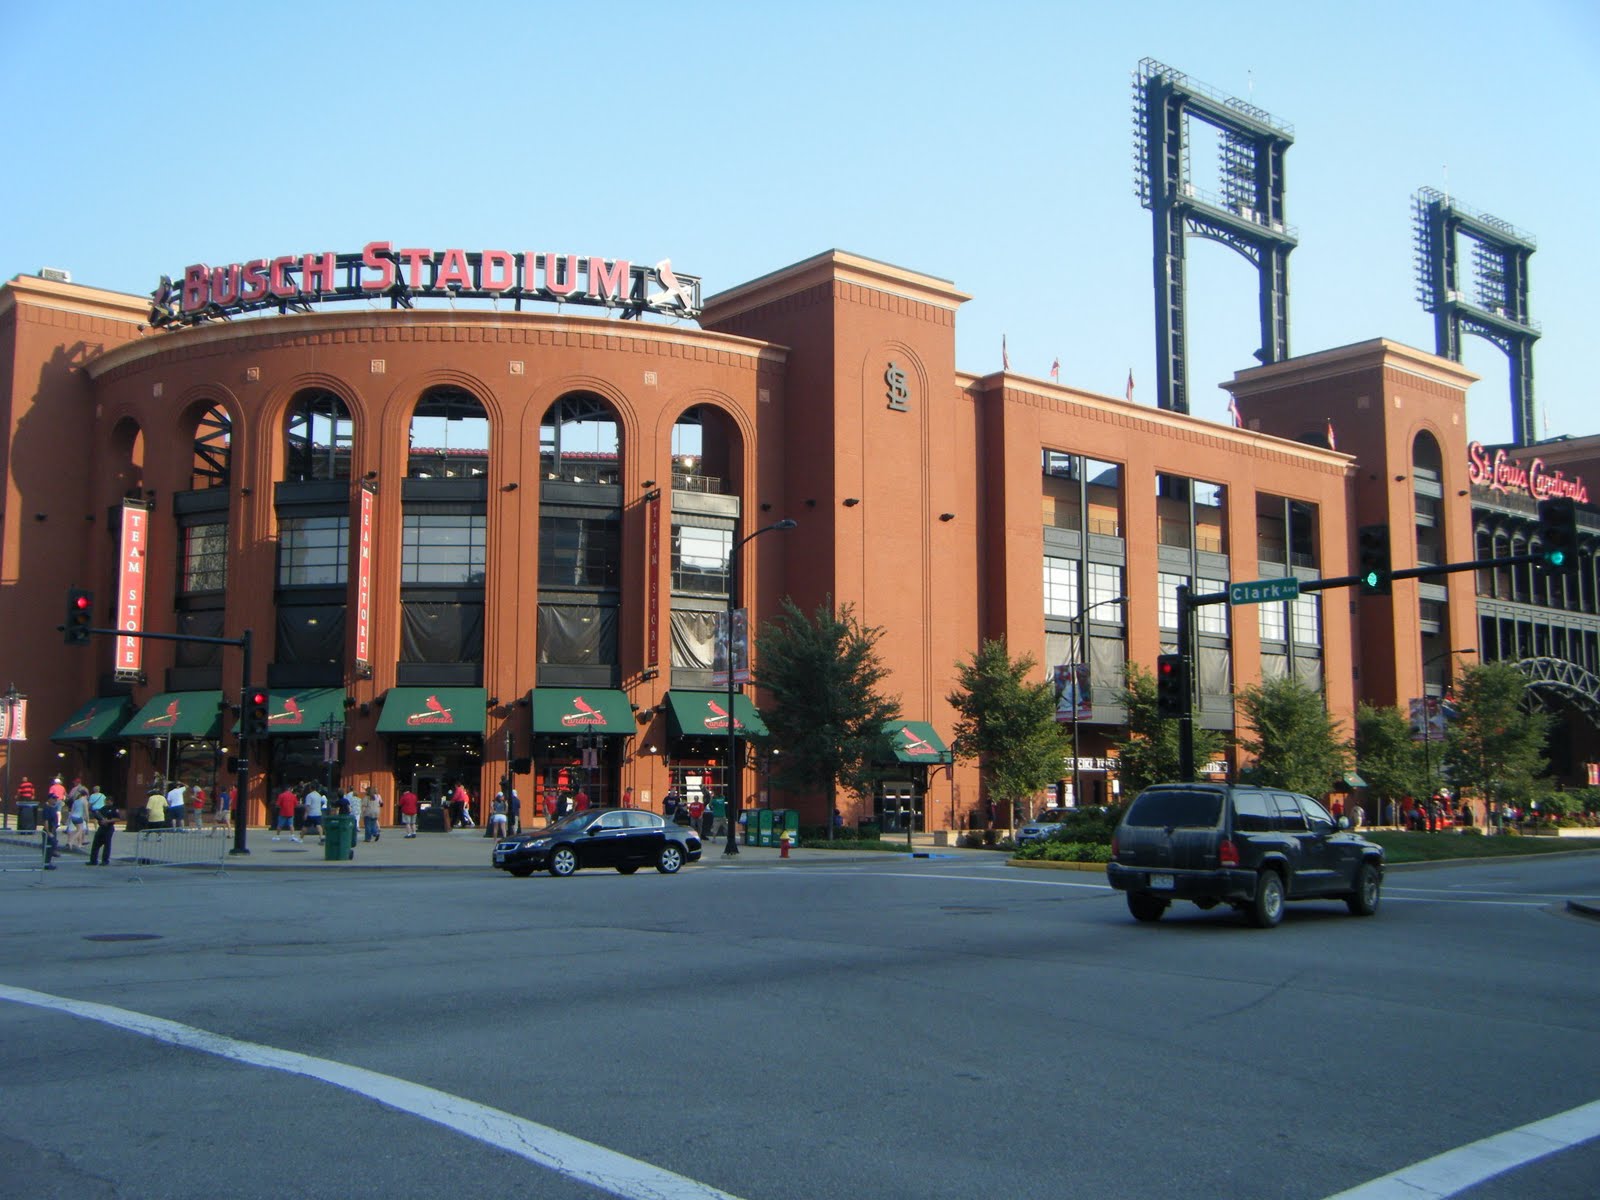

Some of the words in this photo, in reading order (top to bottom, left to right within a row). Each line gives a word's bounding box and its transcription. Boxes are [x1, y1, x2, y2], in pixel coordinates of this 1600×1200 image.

[182, 251, 337, 314] BUSCH
[362, 240, 634, 304] STADIUM
[1489, 449, 1529, 495] Louis
[1529, 458, 1589, 504] Cardinals
[128, 514, 142, 574] TEAM
[1232, 584, 1280, 601] Clark
[125, 589, 137, 664] STORE
[561, 714, 607, 727] Cardinals
